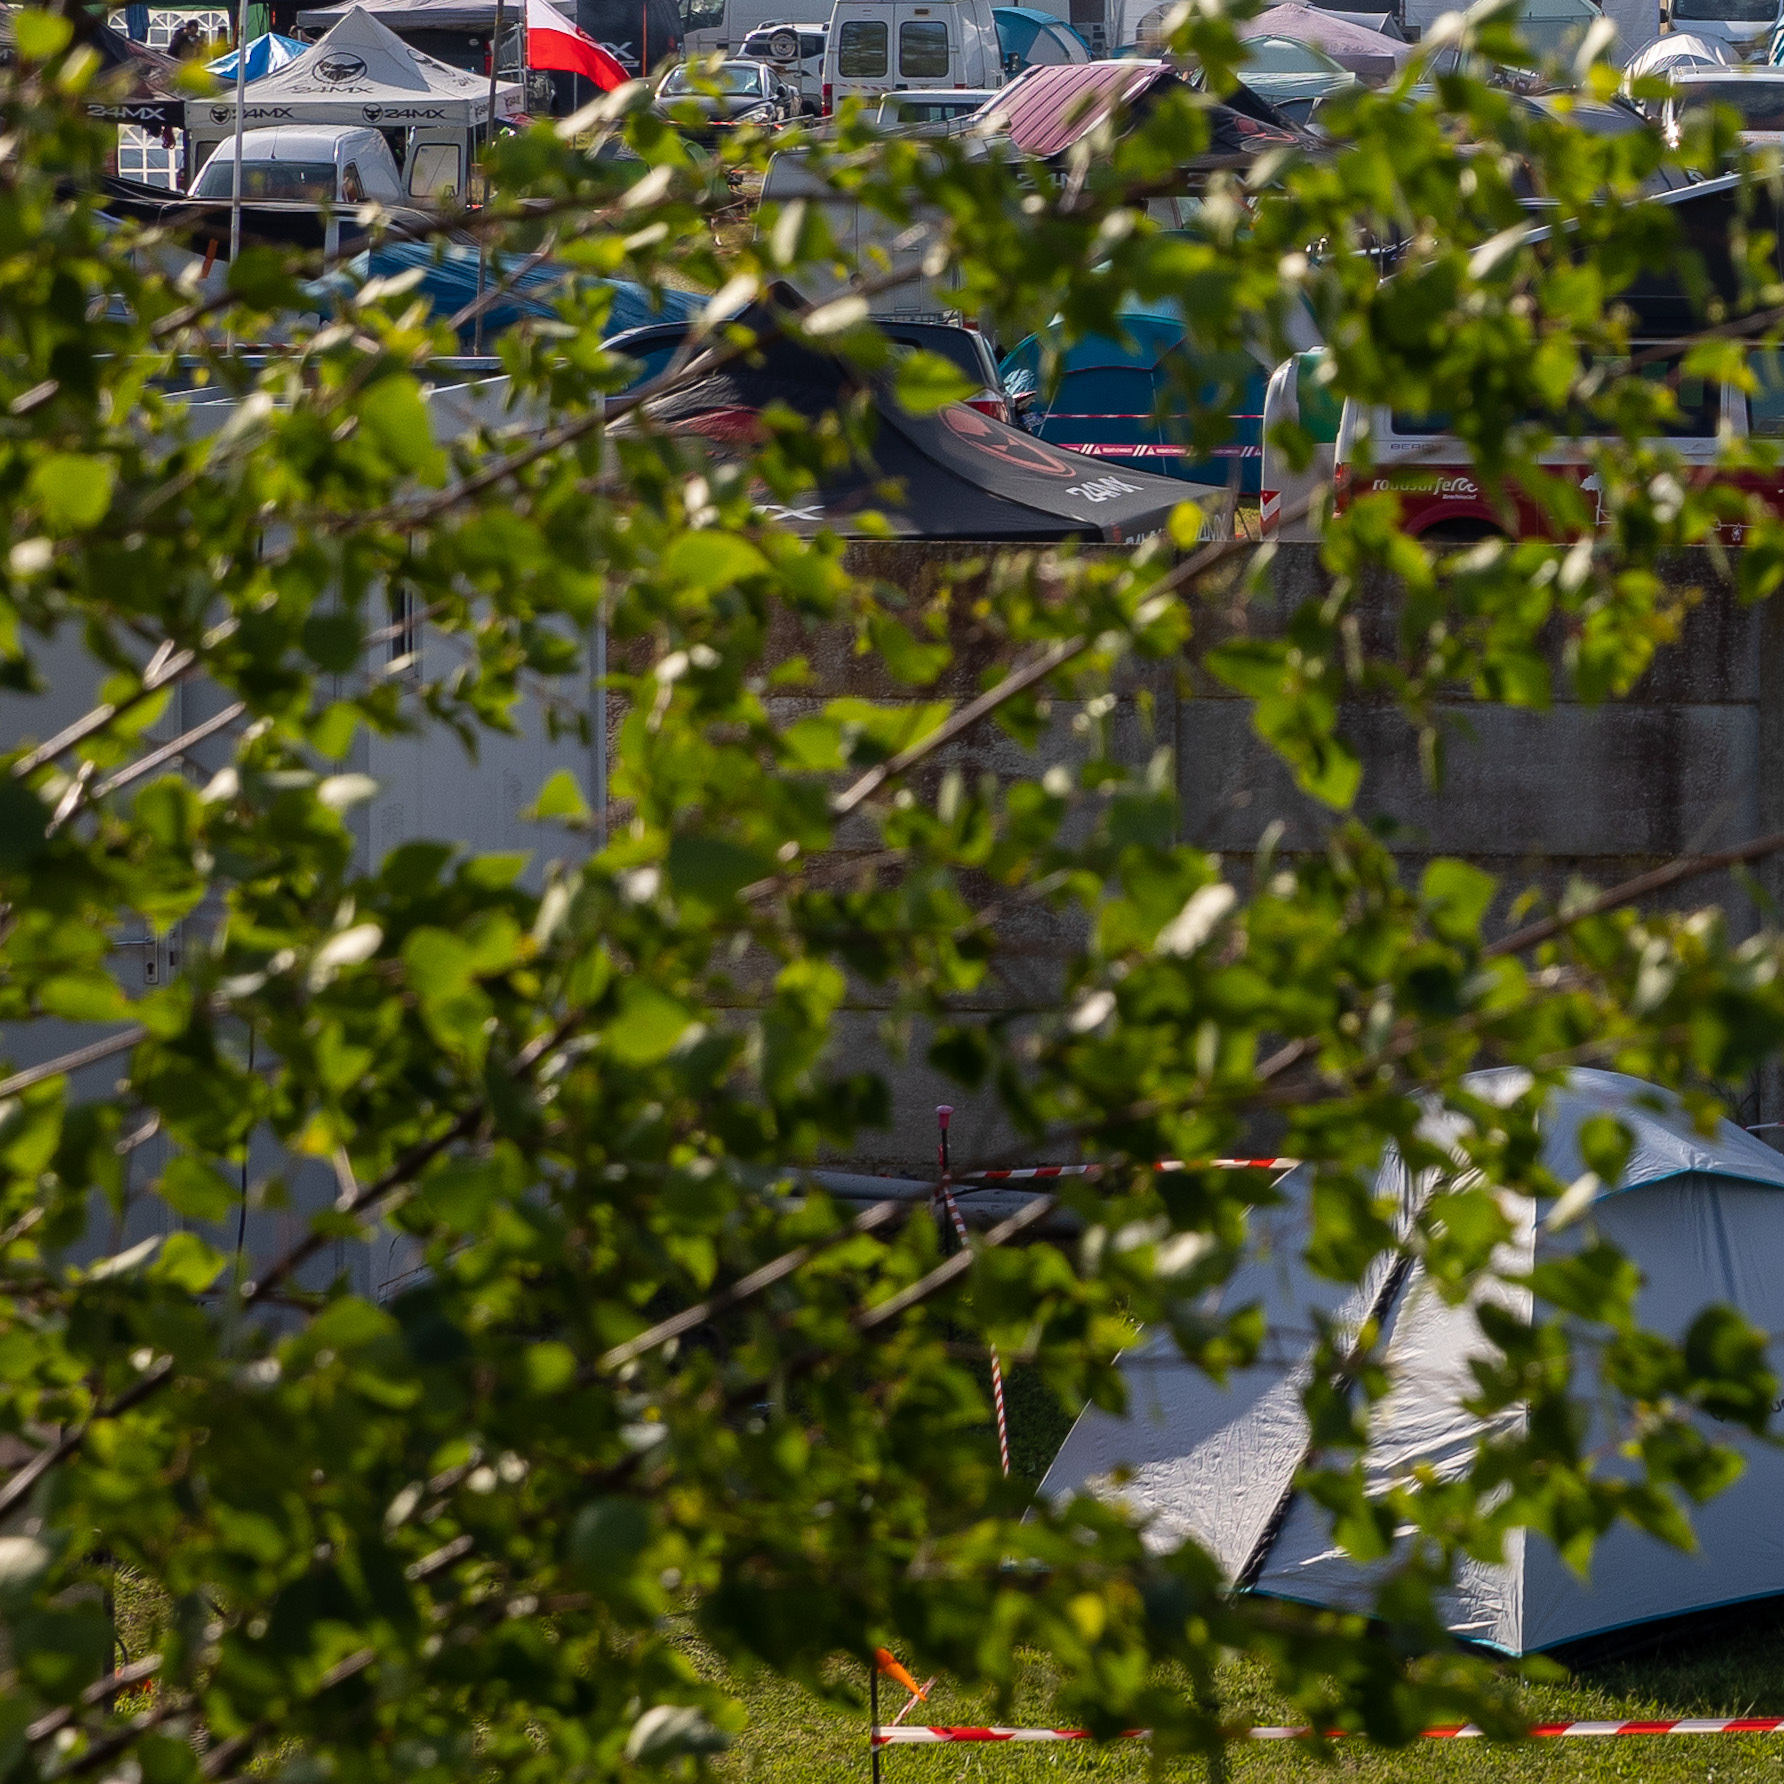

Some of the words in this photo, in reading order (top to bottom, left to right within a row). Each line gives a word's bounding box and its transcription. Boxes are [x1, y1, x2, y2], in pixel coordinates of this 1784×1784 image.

[86, 104, 166, 122] 24MX
[384, 106, 448, 120] 24MX
[1065, 475, 1145, 503] 24MX
